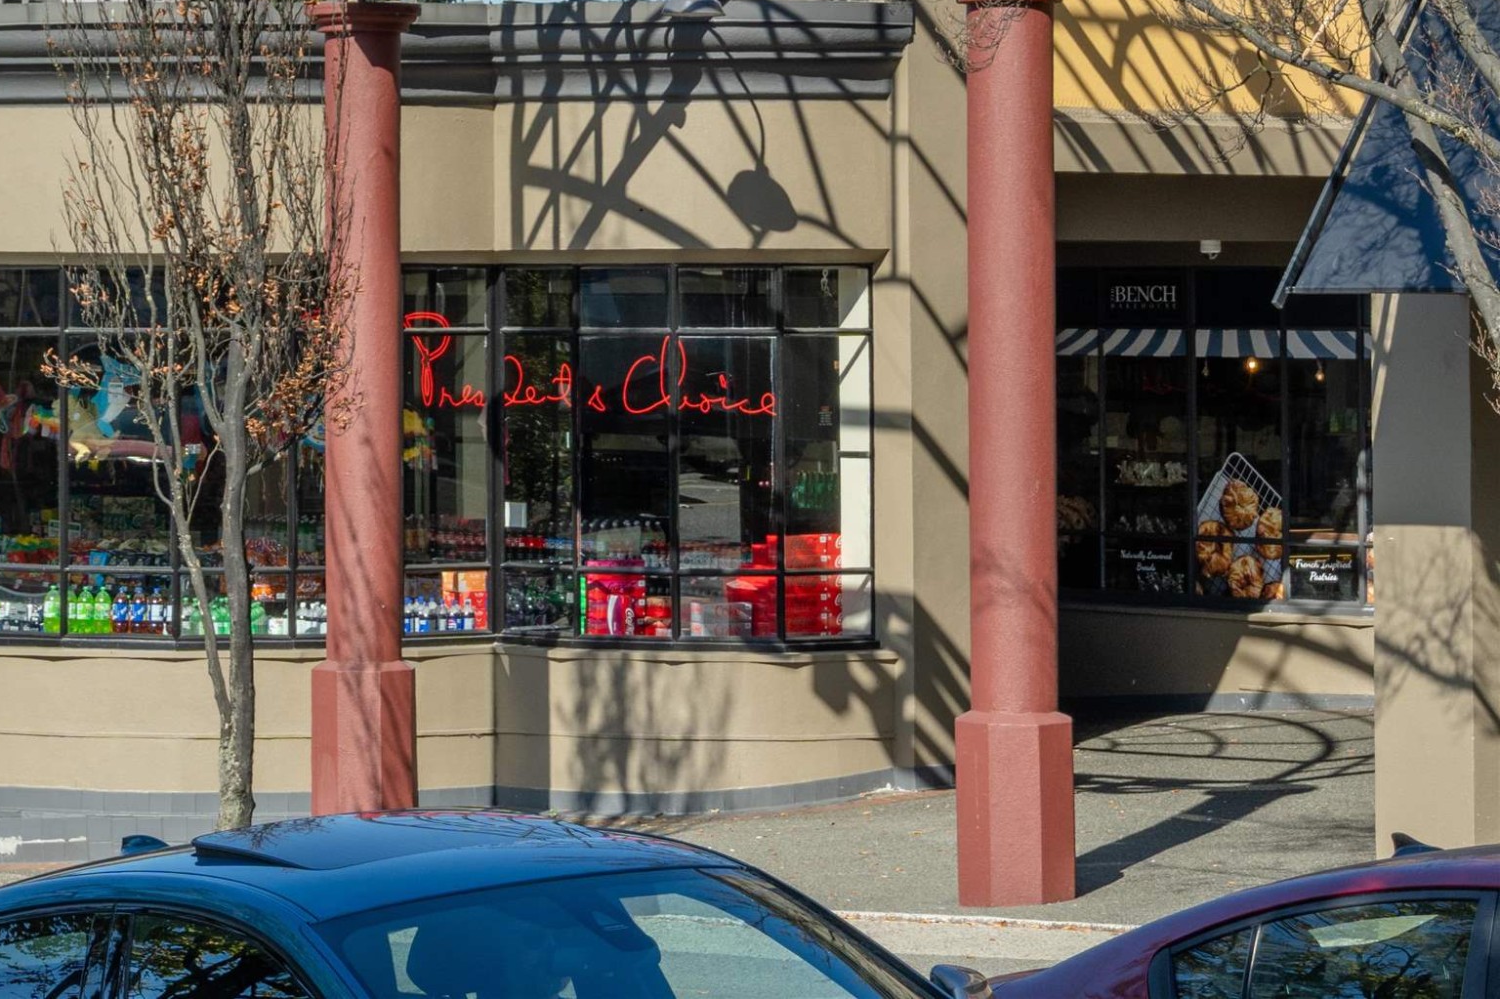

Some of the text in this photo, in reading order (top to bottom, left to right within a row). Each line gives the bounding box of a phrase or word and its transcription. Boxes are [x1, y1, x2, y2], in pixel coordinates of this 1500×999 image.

[1115, 285, 1176, 303] BENCH
[1295, 558, 1319, 569] French
[1309, 571, 1338, 582] Pastries
